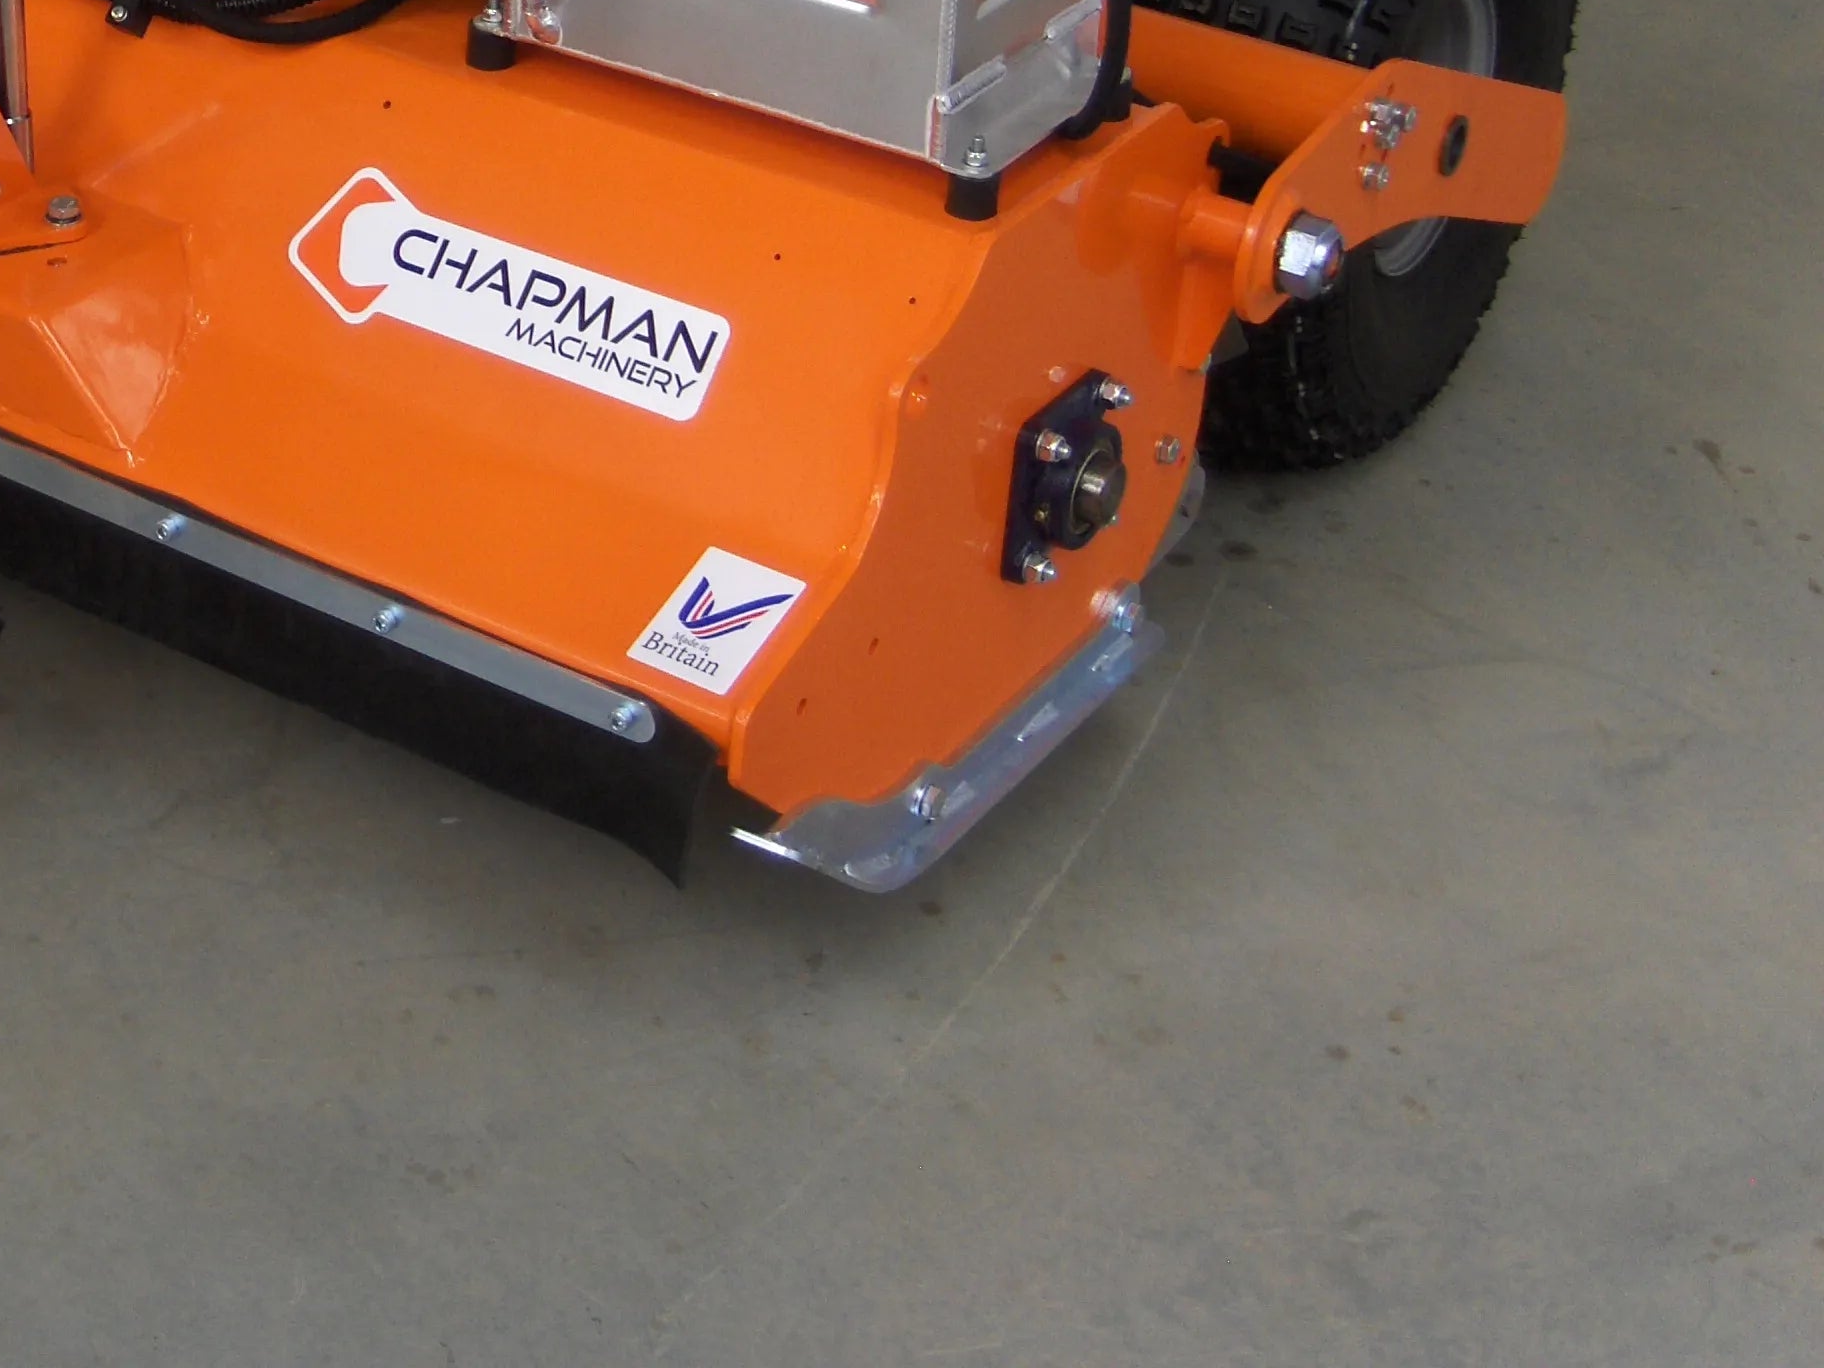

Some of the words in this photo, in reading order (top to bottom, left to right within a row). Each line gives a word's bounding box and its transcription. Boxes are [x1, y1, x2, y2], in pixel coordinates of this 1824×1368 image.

[392, 229, 718, 374] CHAPMAN
[505, 318, 699, 399] MACHINERY
[642, 631, 719, 676] Britain
[672, 632, 699, 648] Made
